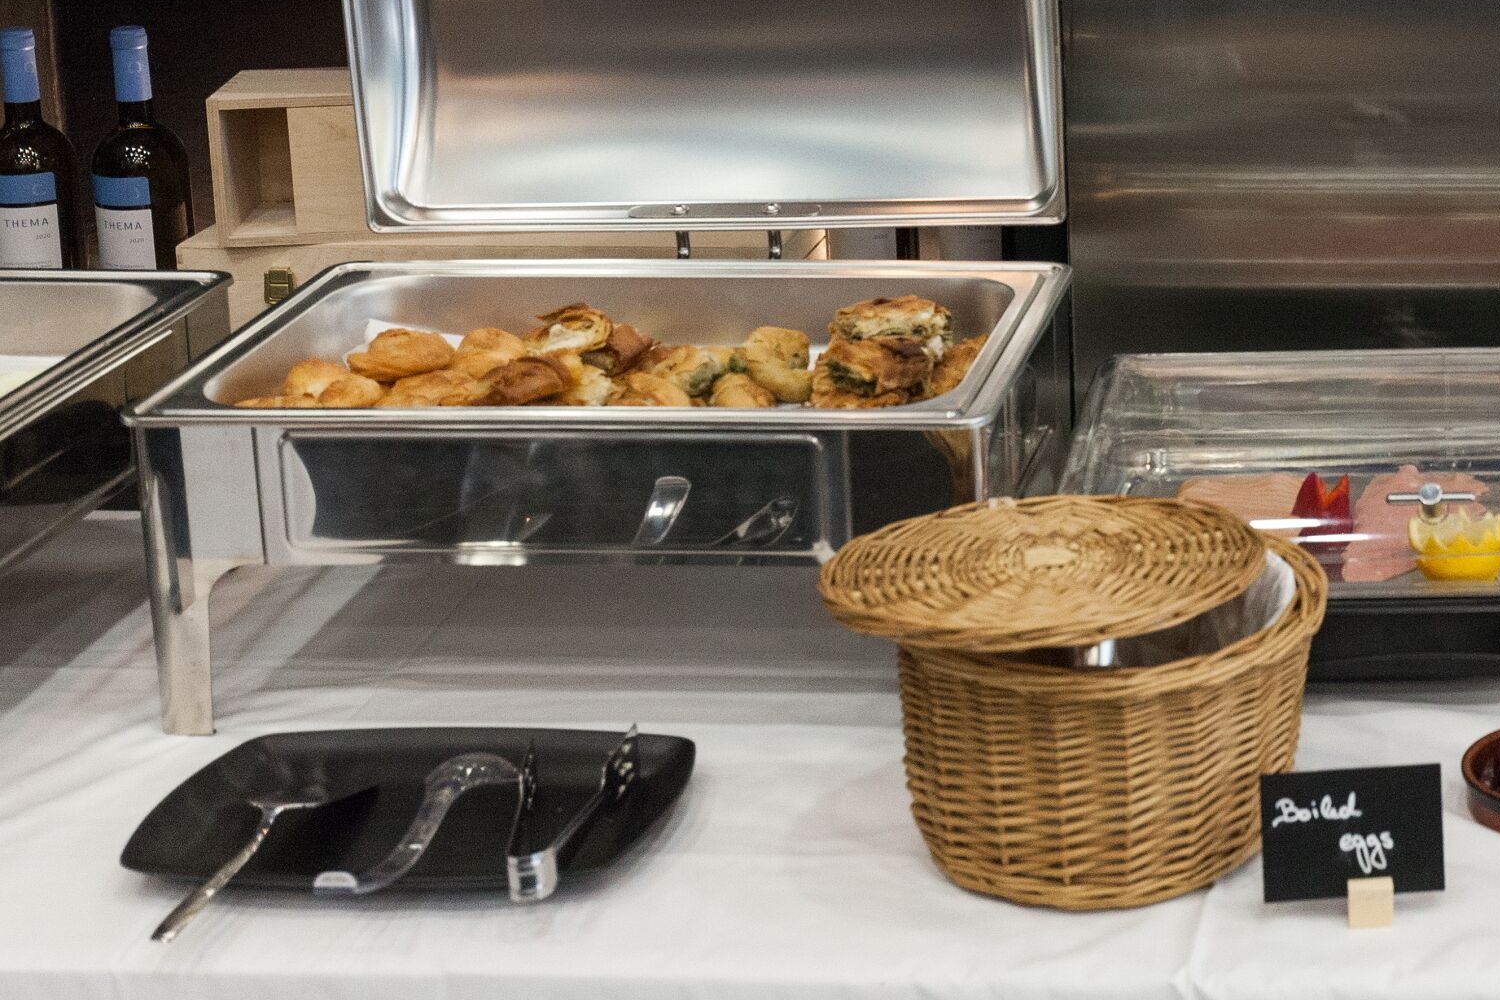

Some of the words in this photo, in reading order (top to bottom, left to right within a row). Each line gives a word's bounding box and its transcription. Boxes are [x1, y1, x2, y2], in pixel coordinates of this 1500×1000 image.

[5, 217, 49, 229] THEMA
[104, 220, 143, 231] THEMA
[1339, 831, 1394, 874] eggs
